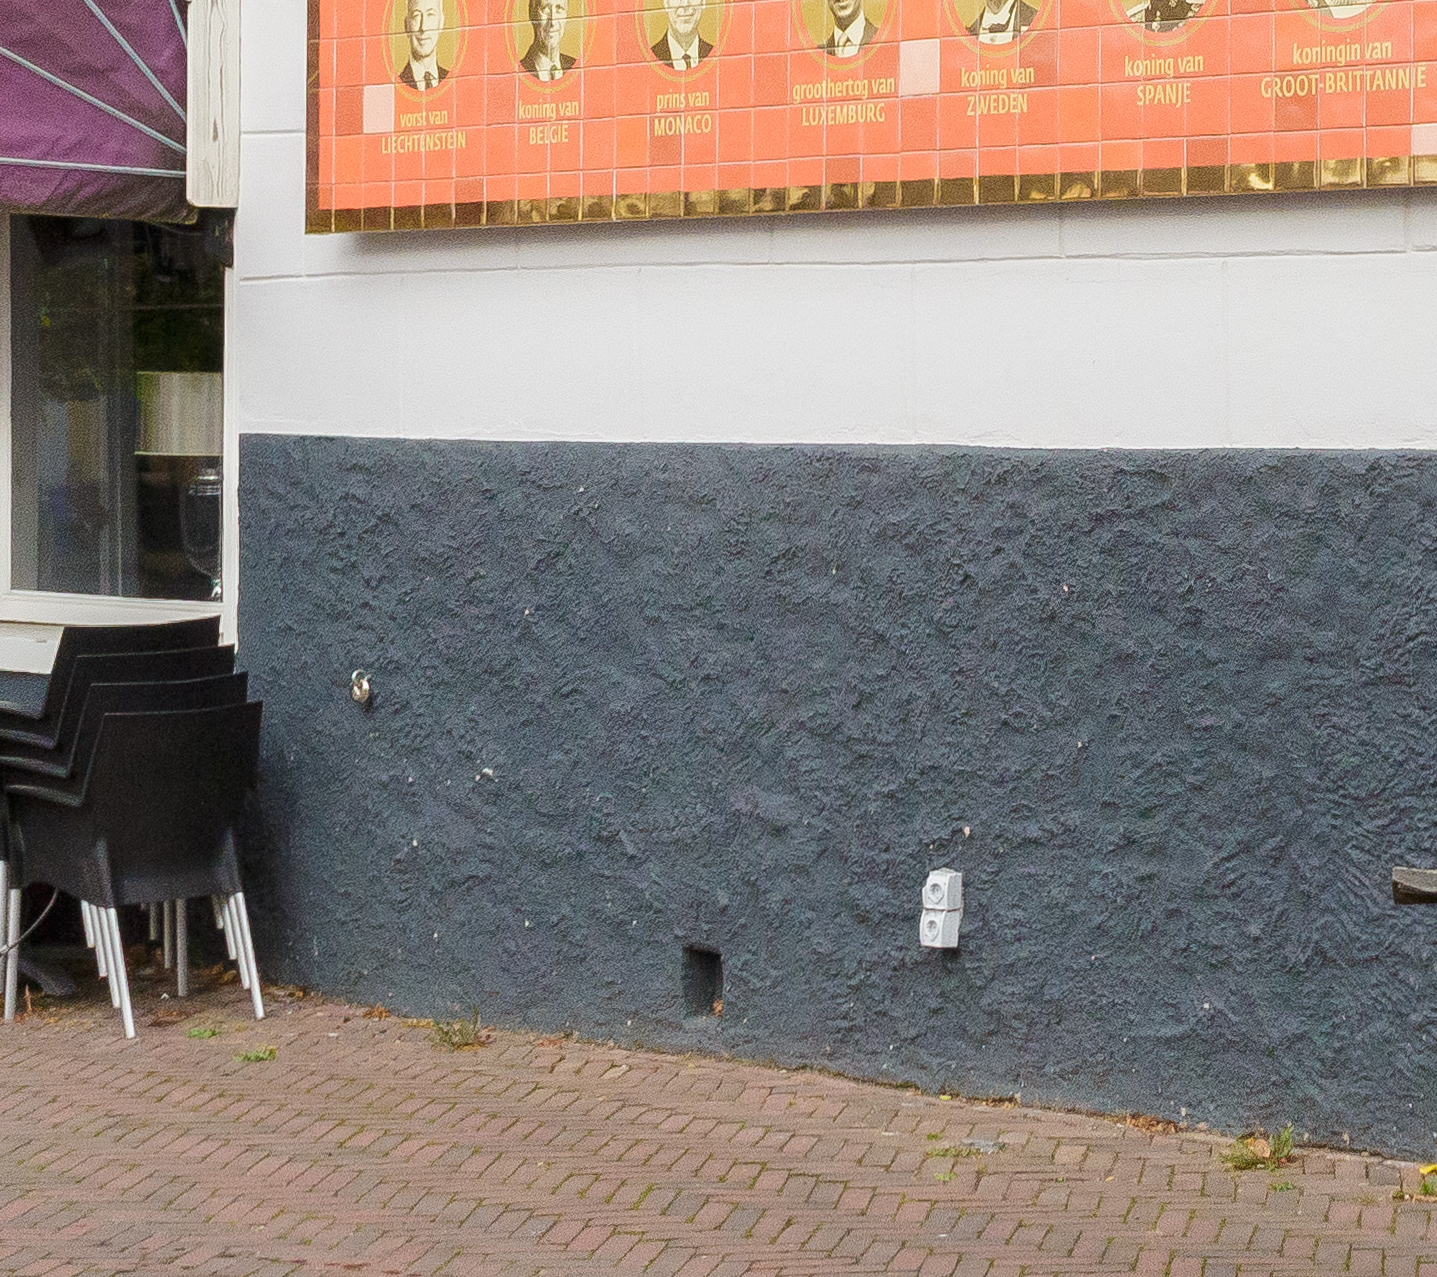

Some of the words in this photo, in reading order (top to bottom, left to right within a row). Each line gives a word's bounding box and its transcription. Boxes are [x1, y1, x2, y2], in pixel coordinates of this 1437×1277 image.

[1292, 38, 1362, 67] koningin
[1364, 39, 1392, 59] van
[960, 65, 1003, 91] koning
[1007, 66, 1034, 84] van
[1123, 53, 1172, 79] koning
[1176, 54, 1204, 73] van
[656, 91, 685, 114] prins
[688, 91, 709, 107] van
[792, 77, 867, 104] groothertog
[870, 77, 895, 94] van
[1136, 81, 1191, 109] SPANJE
[518, 99, 553, 121] koning
[555, 100, 579, 116] van
[801, 101, 886, 127] LUXEMBURG
[966, 92, 1028, 117] ZWEDEN
[399, 109, 424, 127] vorst
[426, 110, 448, 125] van
[653, 112, 711, 136] MONACO
[381, 129, 466, 154] LIECHTENSTEIN
